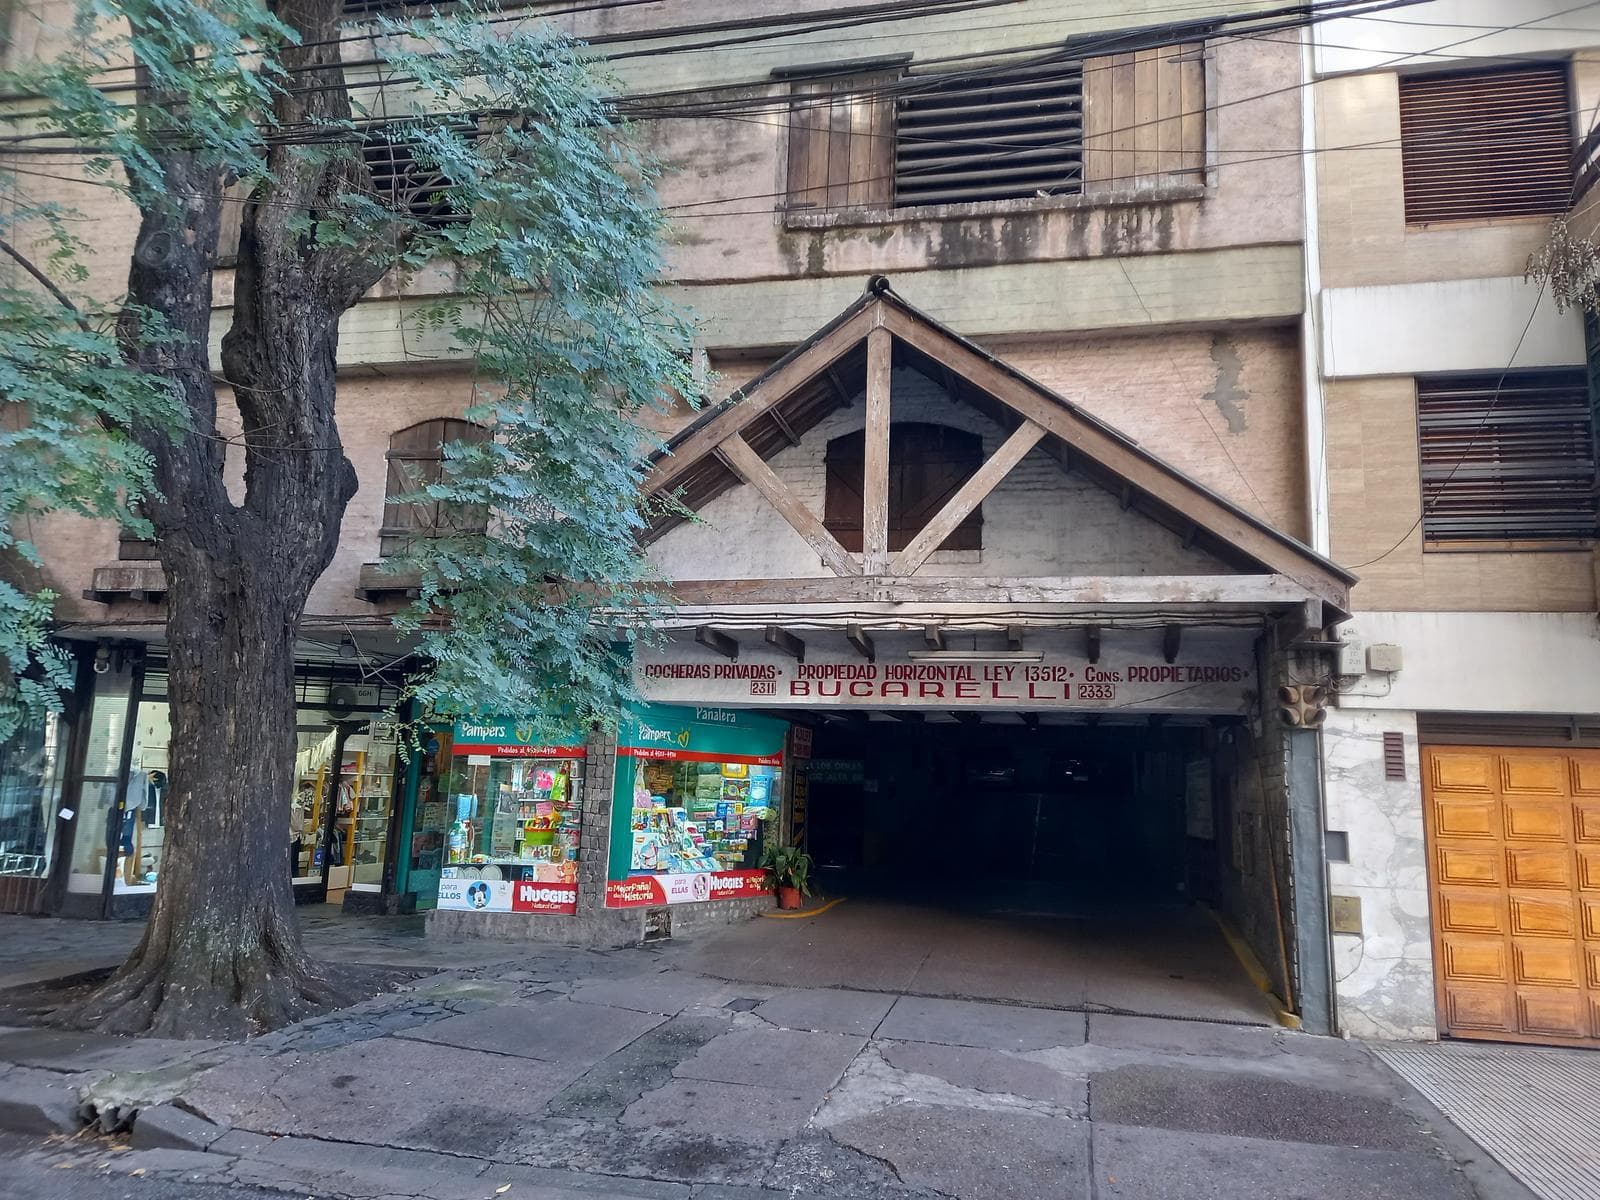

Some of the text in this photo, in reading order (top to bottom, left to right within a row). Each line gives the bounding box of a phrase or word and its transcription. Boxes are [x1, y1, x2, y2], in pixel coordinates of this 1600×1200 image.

[645, 664, 711, 679] COCHERAS
[714, 664, 776, 680] PRIVADAS
[798, 664, 877, 680] PROPIEDAD
[885, 664, 976, 681] HORIZONTAL
[984, 665, 1015, 682] LEY
[1025, 666, 1067, 682] 13512
[1128, 666, 1242, 683] PROPIETARIOS
[790, 681, 1070, 700] BUCARELLI
[1080, 685, 1113, 699] 2333
[461, 721, 506, 741] Pampers
[440, 884, 458, 893] para
[671, 886, 689, 895] ELLAS
